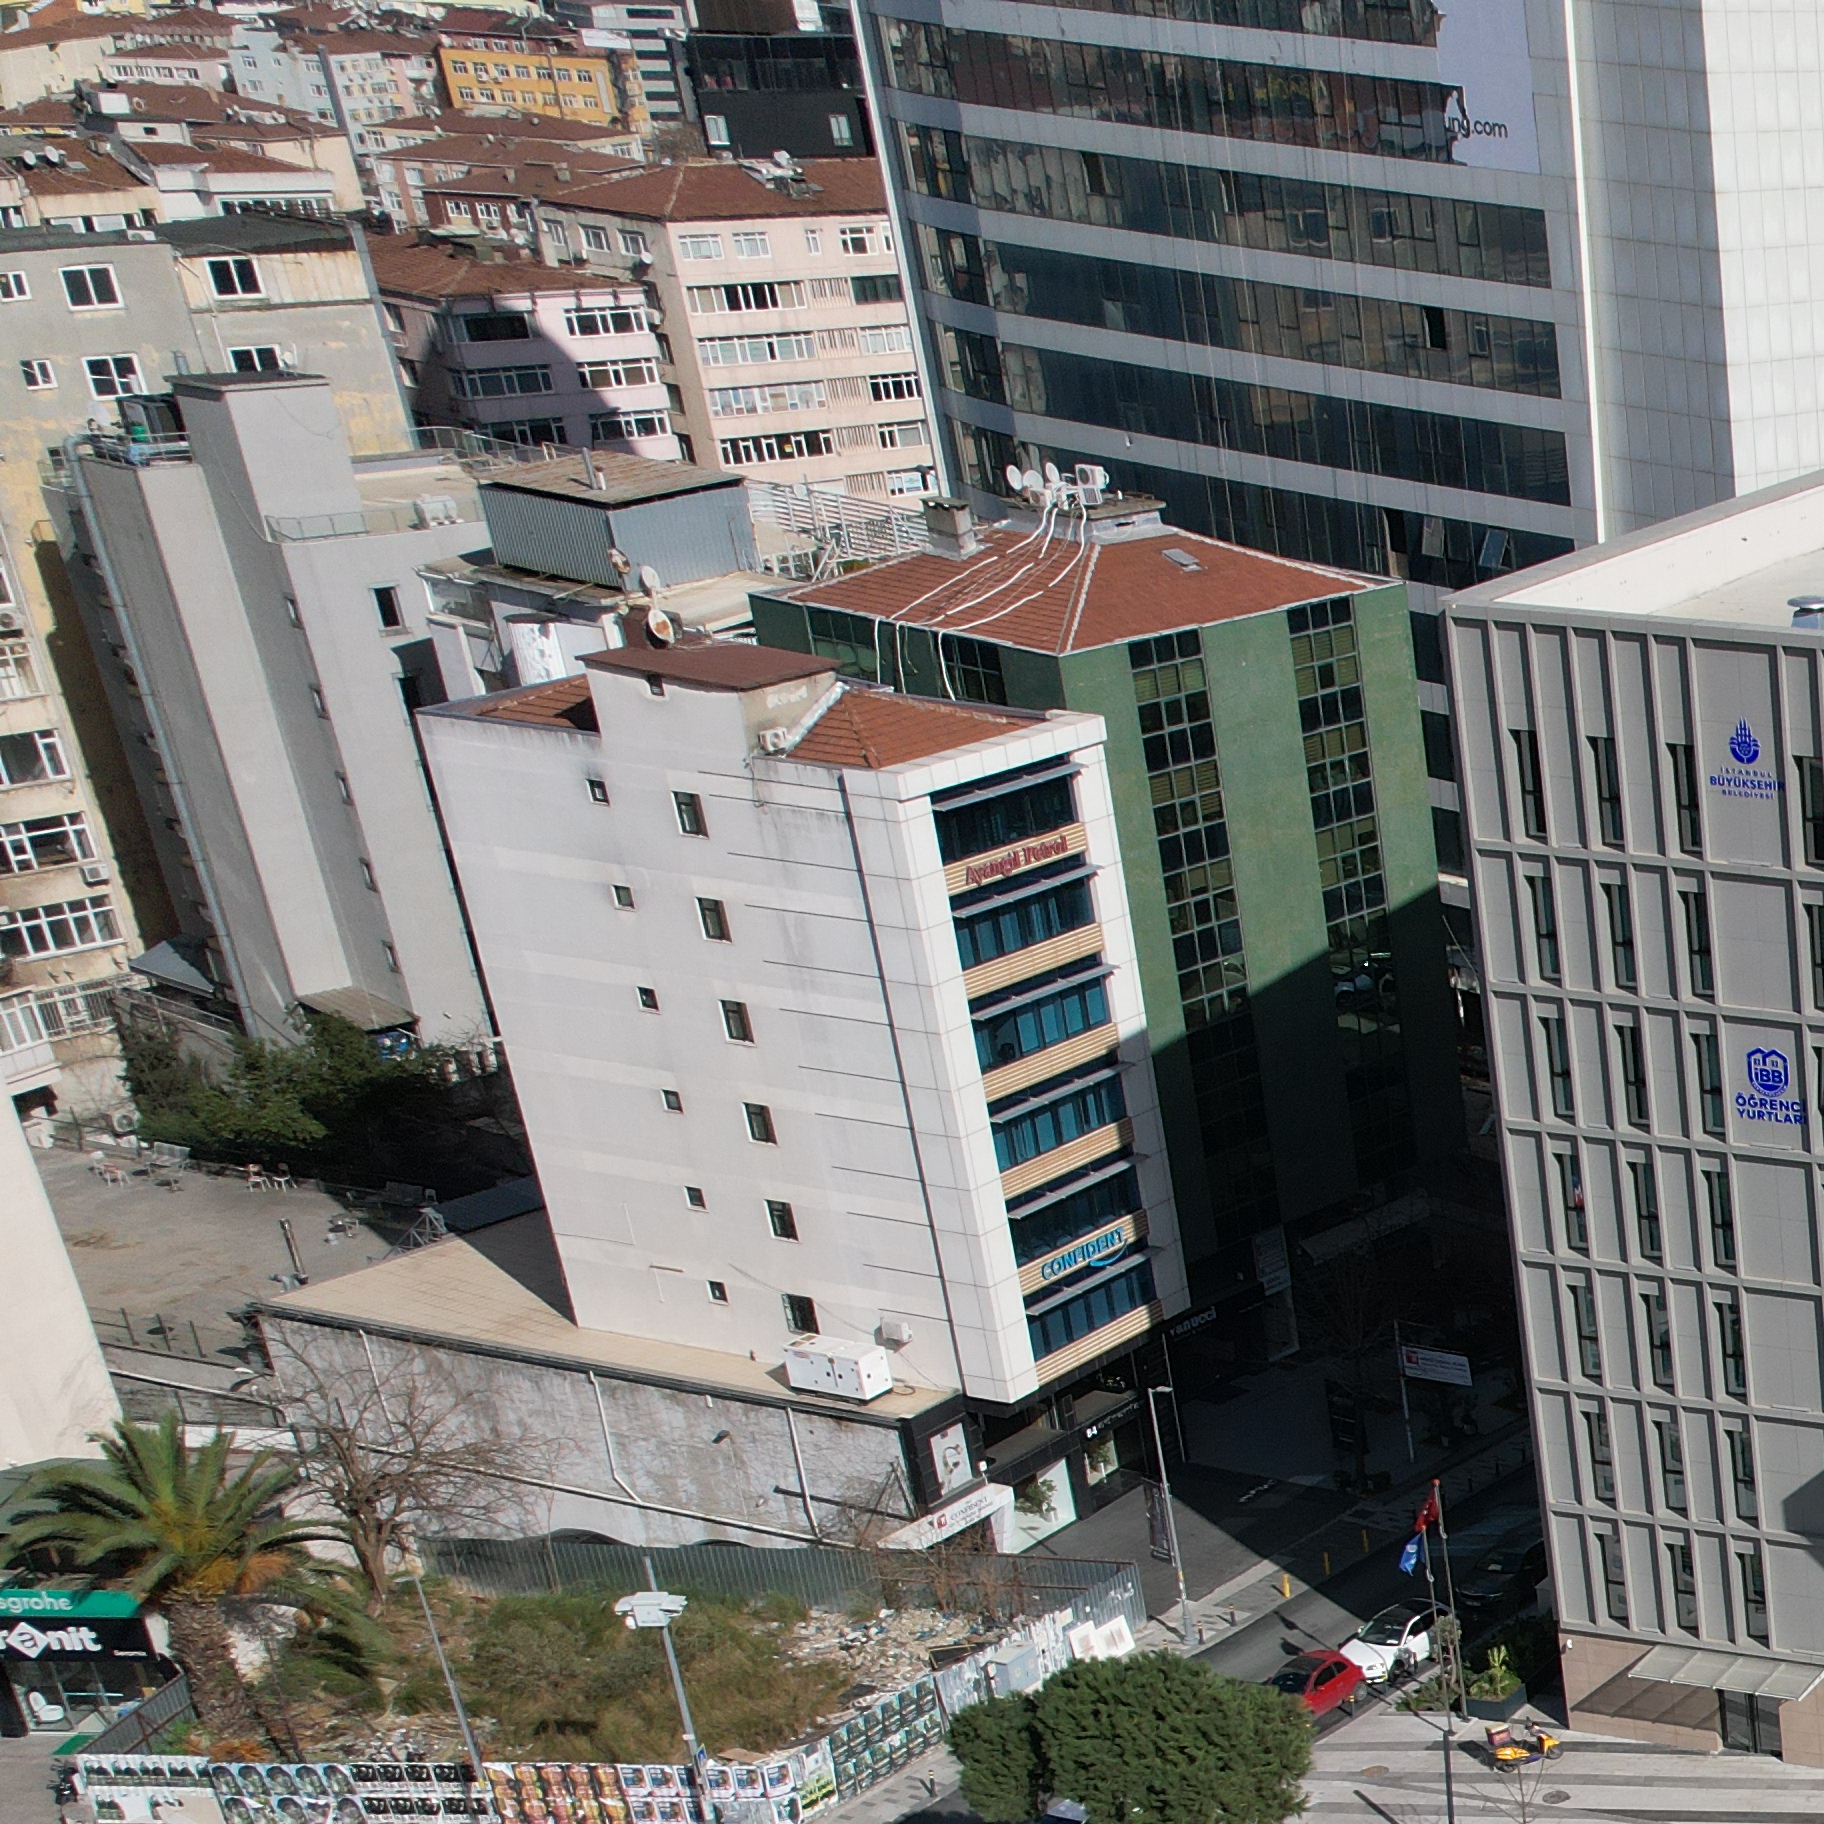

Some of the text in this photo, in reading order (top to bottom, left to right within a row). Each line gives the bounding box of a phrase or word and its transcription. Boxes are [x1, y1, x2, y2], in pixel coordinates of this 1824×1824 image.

[1720, 765, 1772, 779] İSTANBUL
[1709, 775, 1786, 793] BÜYÜKŞEHİR
[1722, 789, 1774, 801] BELEDİYESİ
[1736, 1107, 1807, 1125] YURTLARI
[1041, 1226, 1125, 1281] CONFIDENT
